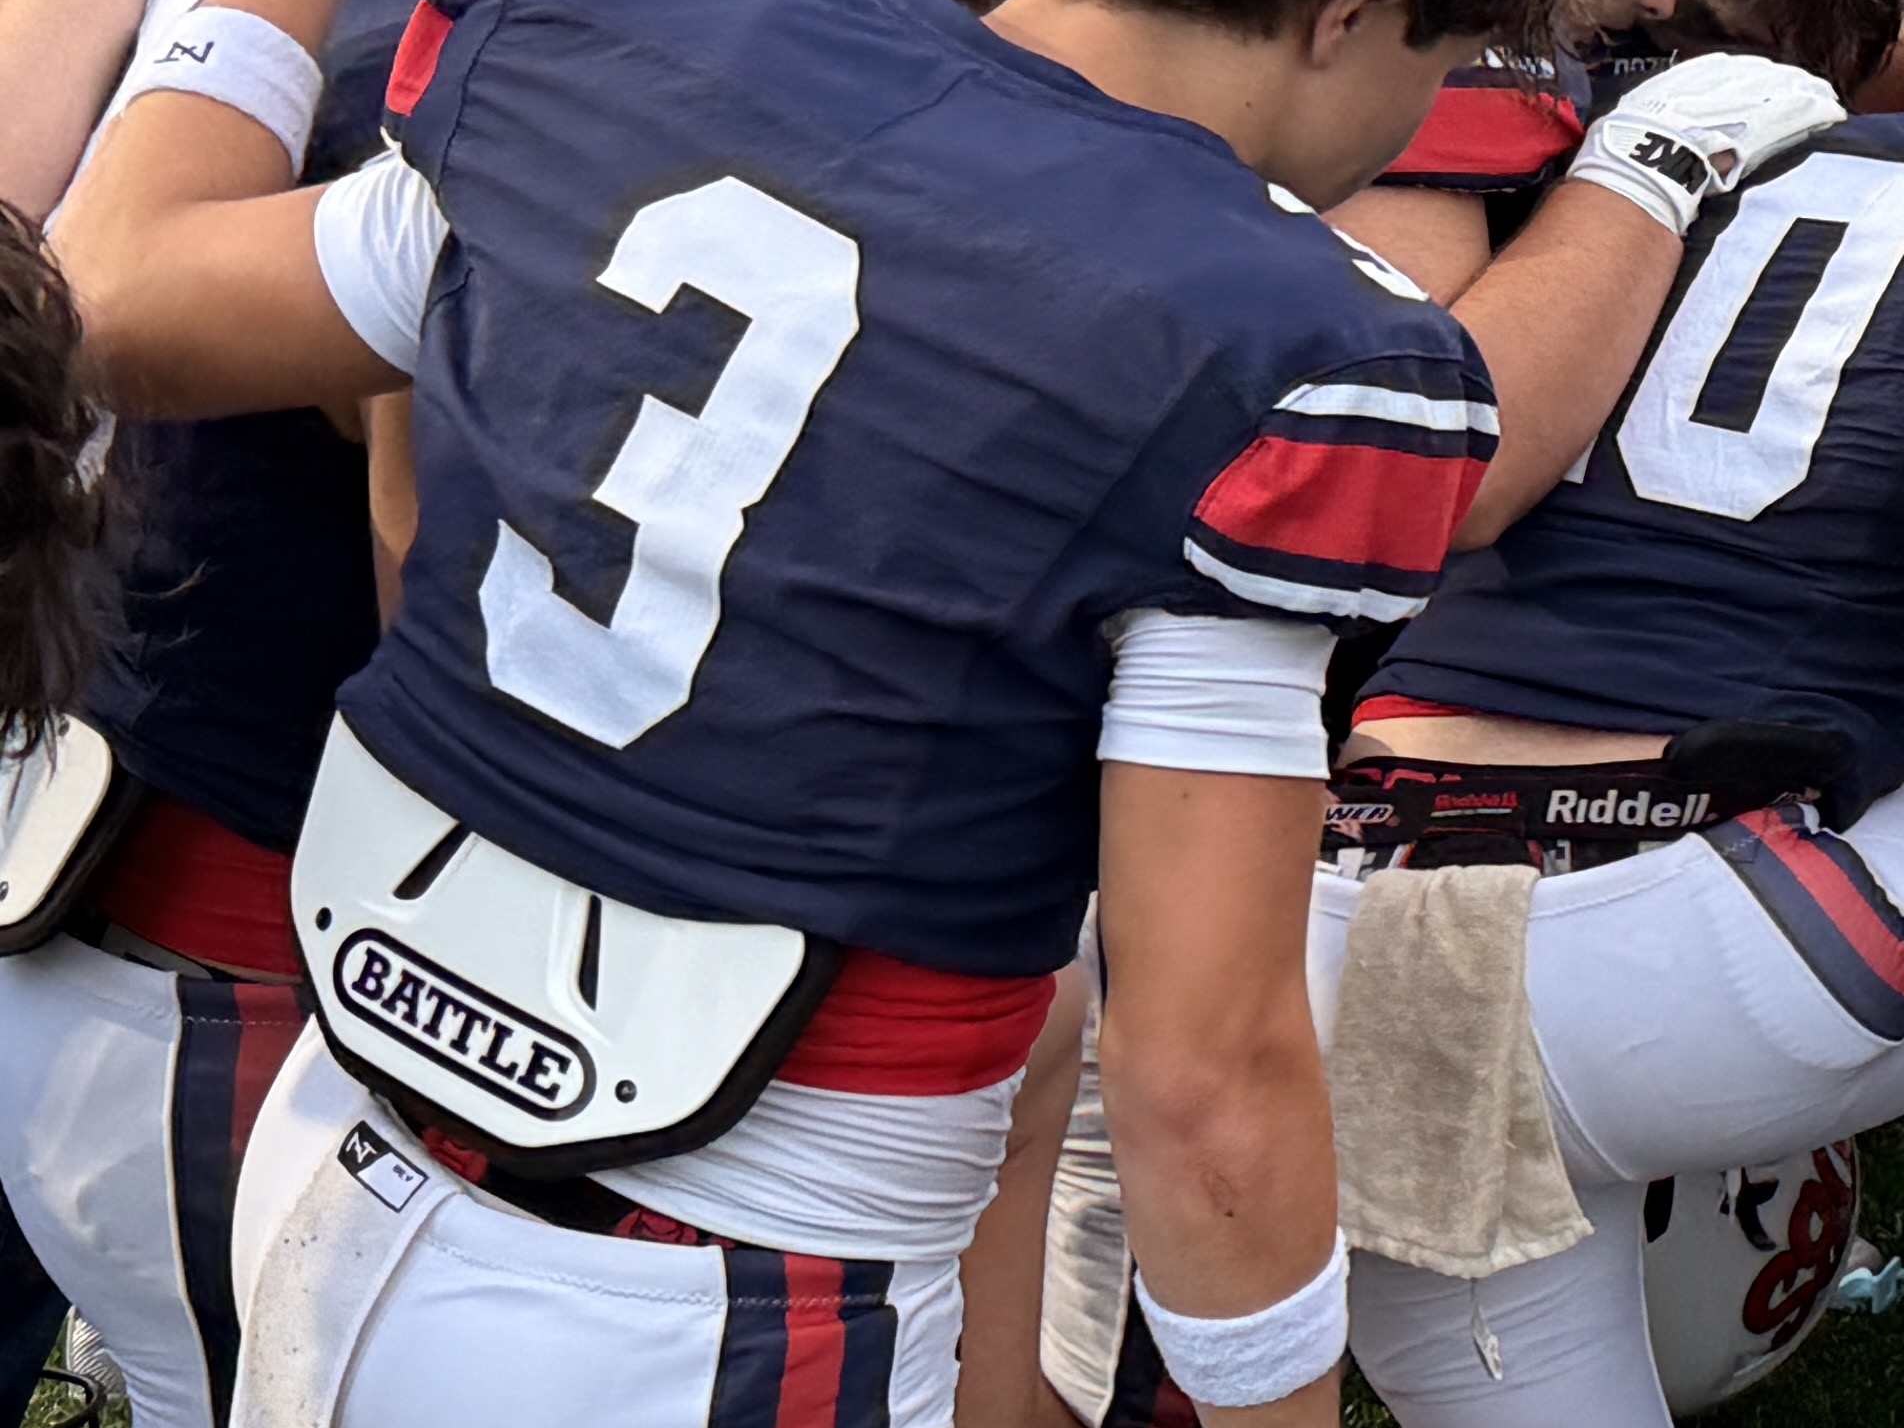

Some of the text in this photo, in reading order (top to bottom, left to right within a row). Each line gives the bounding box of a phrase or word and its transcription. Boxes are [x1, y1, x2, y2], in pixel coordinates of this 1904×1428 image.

[477, 174, 861, 751] 3
[1545, 787, 1712, 828] Riddell
[351, 944, 574, 1108] BATTLE
